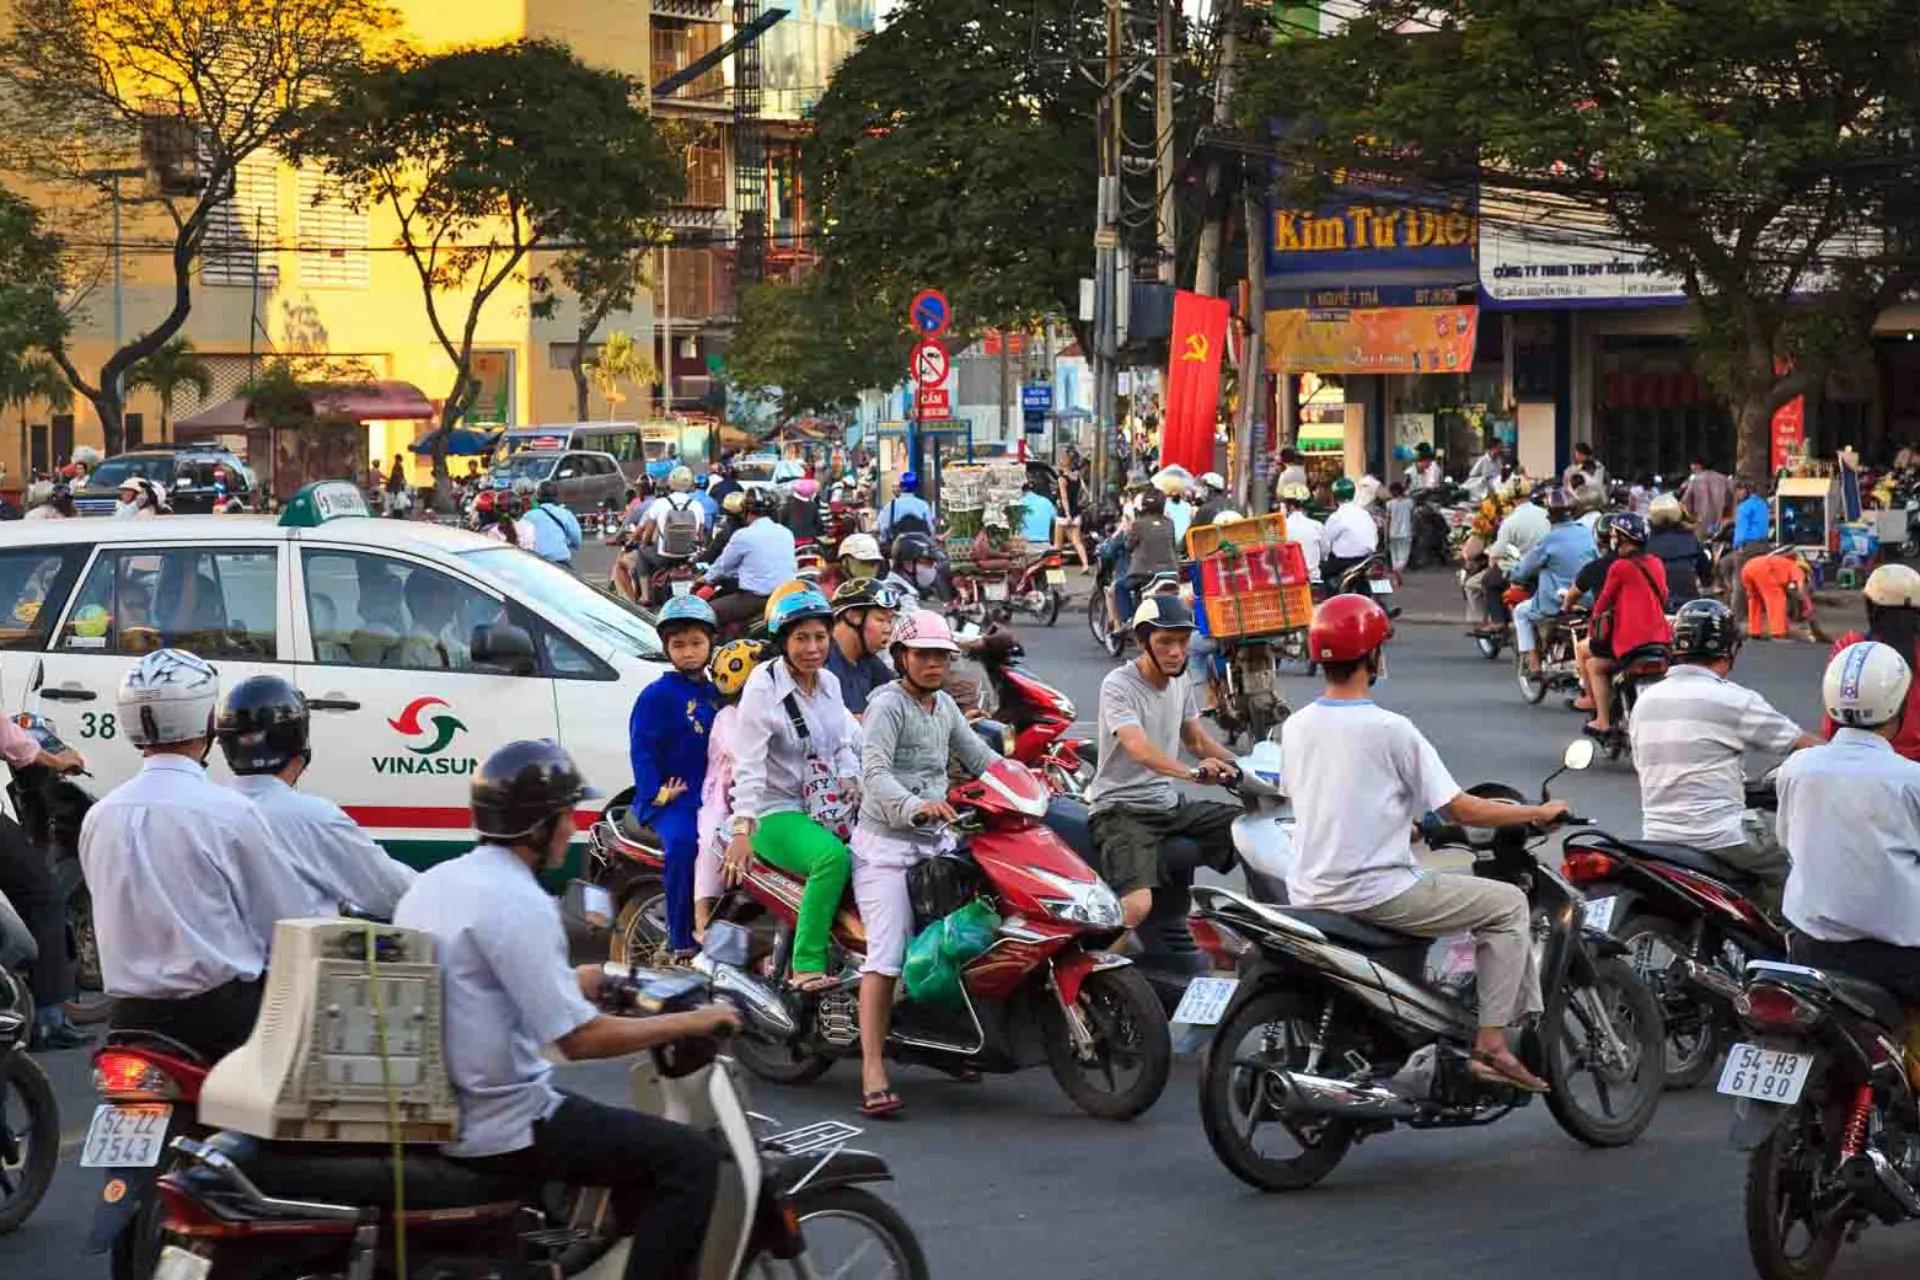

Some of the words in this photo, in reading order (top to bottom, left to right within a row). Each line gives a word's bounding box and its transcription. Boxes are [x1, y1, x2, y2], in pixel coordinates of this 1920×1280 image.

[1274, 208, 1345, 250] Kim
[80, 711, 116, 739] 38
[1732, 1070, 1791, 1098] 6190
